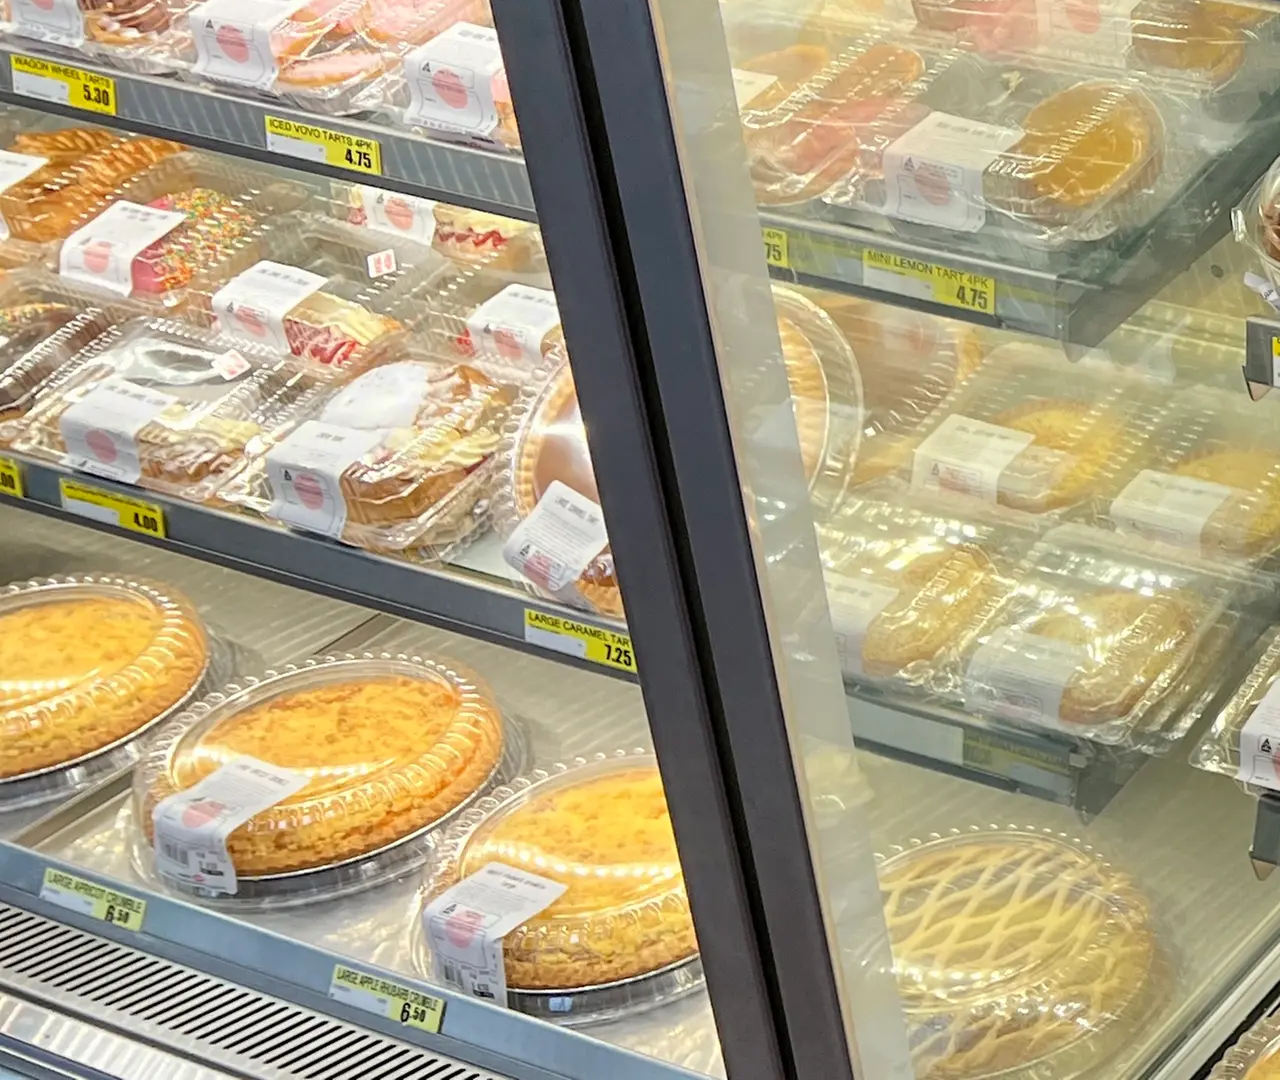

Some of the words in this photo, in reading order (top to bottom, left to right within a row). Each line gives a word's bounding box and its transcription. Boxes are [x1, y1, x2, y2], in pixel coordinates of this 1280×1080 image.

[12, 56, 50, 73] WAGON
[51, 64, 81, 81] WHEEL
[81, 72, 112, 88] TARTS
[82, 84, 110, 106] 5.30
[269, 118, 292, 133] ICED
[293, 123, 322, 139] VOVO
[322, 129, 353, 147] TARTS
[354, 137, 373, 150] 4PK
[344, 148, 372, 169] 4.75
[867, 250, 892, 265] MINI
[893, 256, 933, 275] LEMON
[934, 267, 964, 282] TART
[966, 275, 988, 289] 4PK
[956, 286, 988, 310] 4.75
[134, 512, 157, 532] 4.00
[529, 612, 561, 629] LARGE
[563, 621, 608, 642] CARAMEL
[608, 635, 630, 647] TAR
[604, 644, 632, 667] 7.25
[46, 869, 72, 892] LARGE
[73, 879, 104, 902] APRICOT
[104, 889, 143, 914] CRUMBLE
[104, 904, 130, 925] 6.50
[335, 966, 359, 985] LARGE
[359, 974, 379, 992] APPLE
[408, 990, 438, 1011] CRUMBLE
[400, 1002, 427, 1023] 6.50
